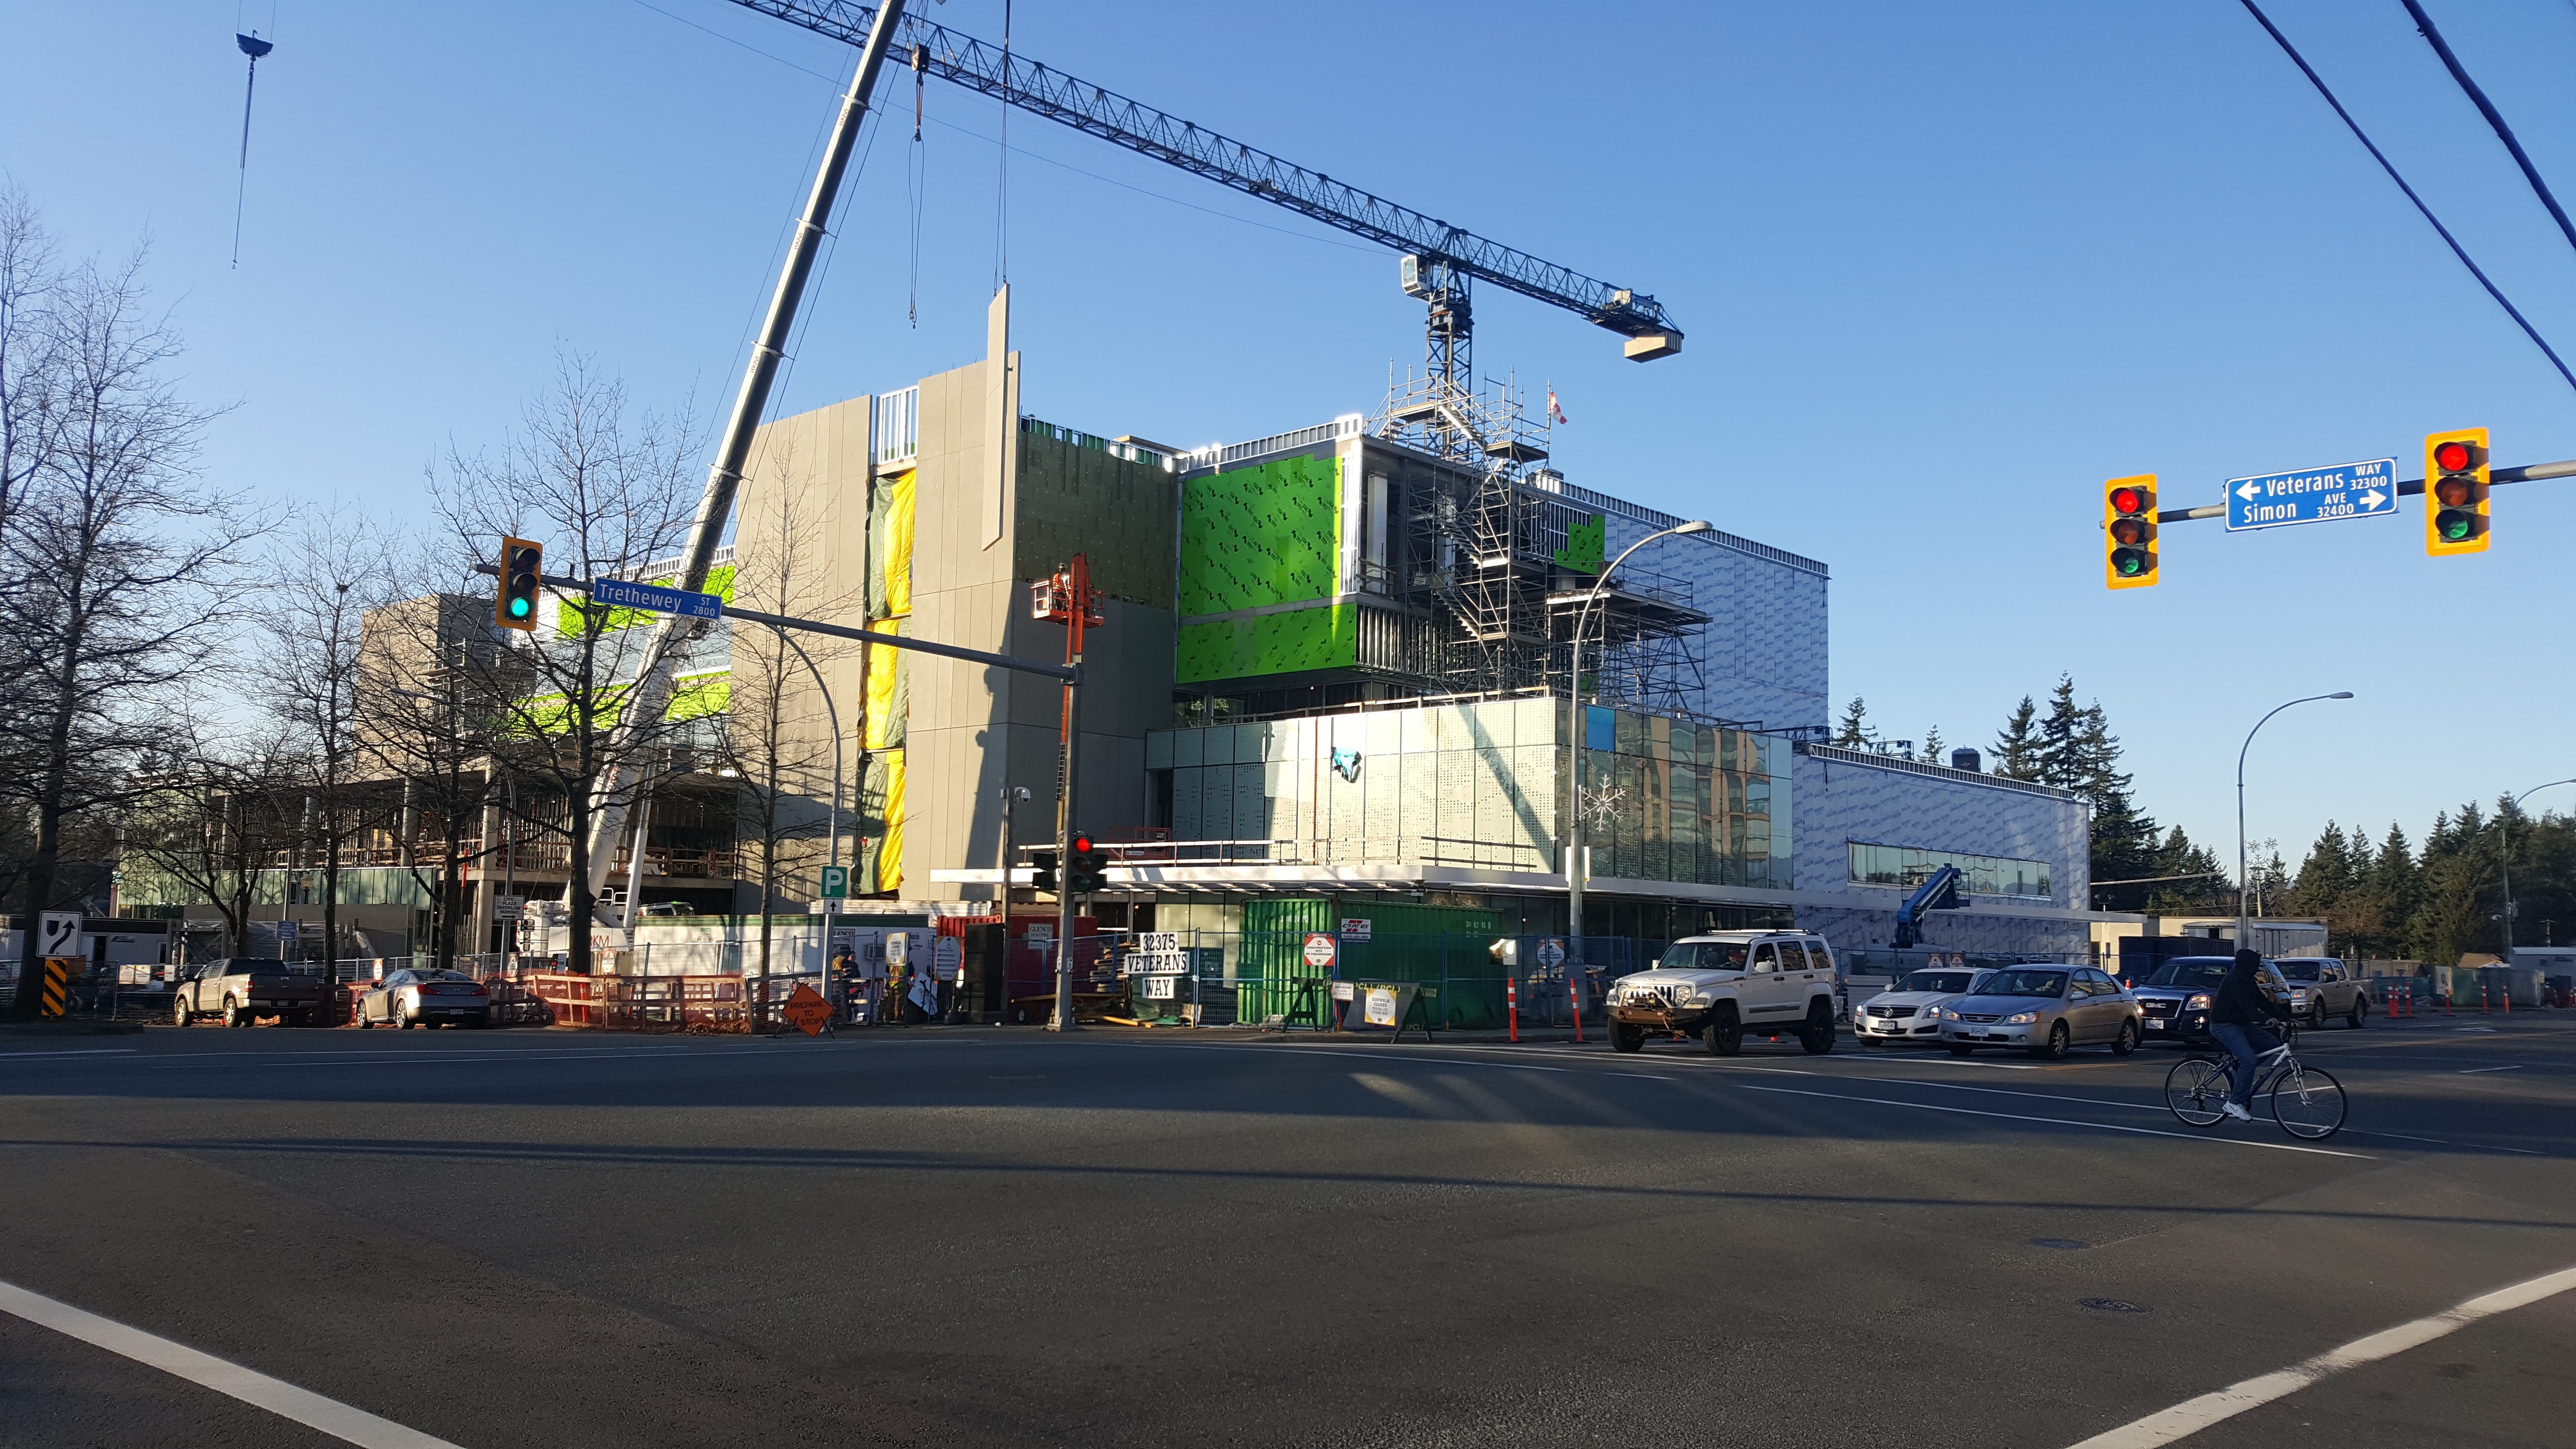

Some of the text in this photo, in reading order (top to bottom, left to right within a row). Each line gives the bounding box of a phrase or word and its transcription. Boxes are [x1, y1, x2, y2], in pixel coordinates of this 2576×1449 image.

[838, 109, 848, 126] RKM
[793, 233, 803, 249] RKM
[750, 356, 760, 373] RKM
[2267, 463, 2382, 497] Veterans WAY
[2350, 475, 2387, 491] 32300
[2324, 492, 2346, 505] AVE
[2243, 502, 2296, 523] Simon
[2317, 503, 2354, 518] 32400
[600, 583, 710, 613] Trethewey ST
[693, 605, 715, 616] 2800
[825, 869, 843, 895] P
[1143, 934, 1175, 951] 32375
[1128, 954, 1187, 972] VETERANS
[1145, 980, 1170, 996] WAY
[790, 1001, 823, 1009] PREPARE
